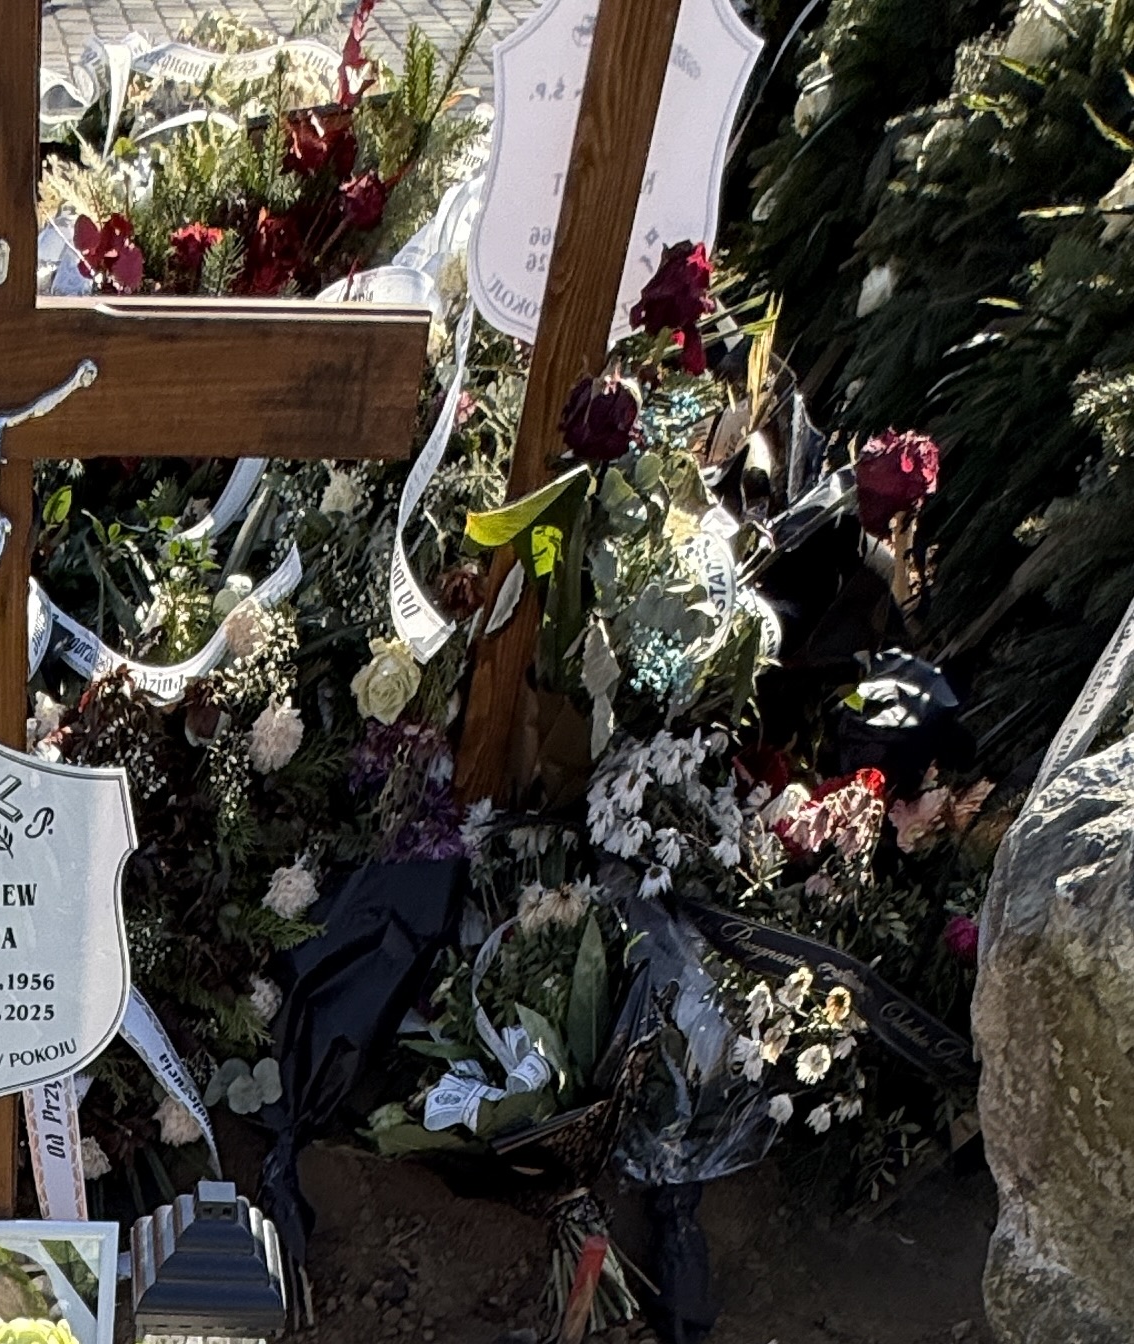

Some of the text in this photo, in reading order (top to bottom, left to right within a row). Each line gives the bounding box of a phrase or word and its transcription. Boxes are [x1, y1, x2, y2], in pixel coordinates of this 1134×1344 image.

[24, 806, 54, 839] P.
[9, 1037, 78, 1068] POKOJU
[45, 1132, 67, 1160] Od
